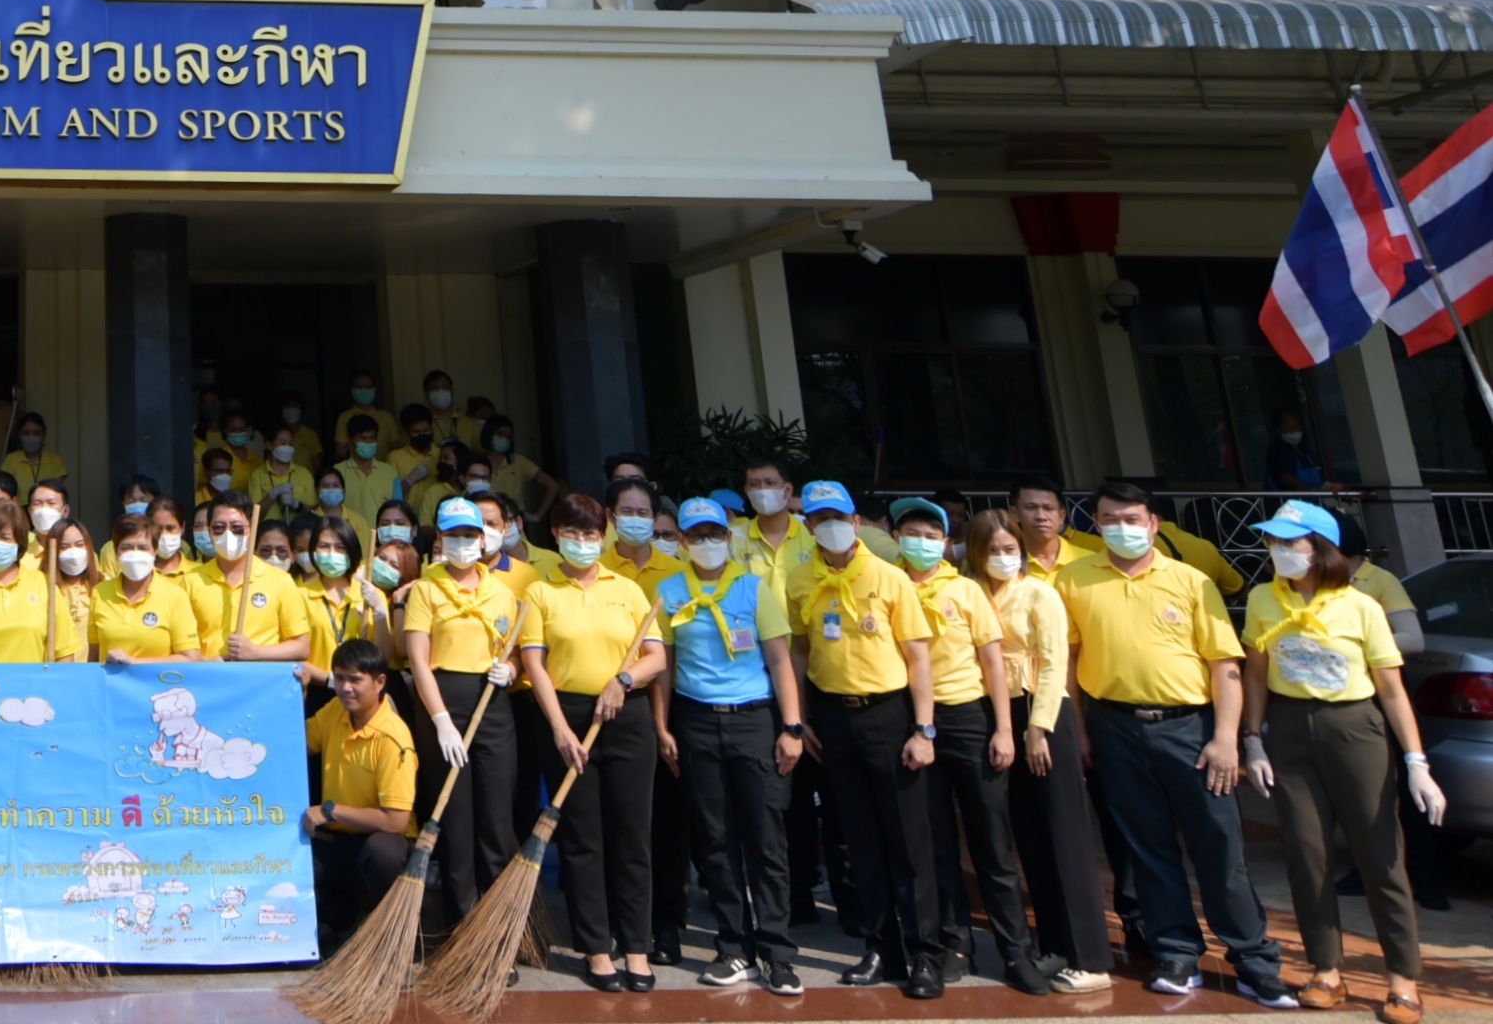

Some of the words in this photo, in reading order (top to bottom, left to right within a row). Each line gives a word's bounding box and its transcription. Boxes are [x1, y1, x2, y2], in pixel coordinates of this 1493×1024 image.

[59, 107, 159, 139] AND
[177, 109, 346, 142] SPORTS
[151, 793, 286, 827] ด้วยหัวใจ
